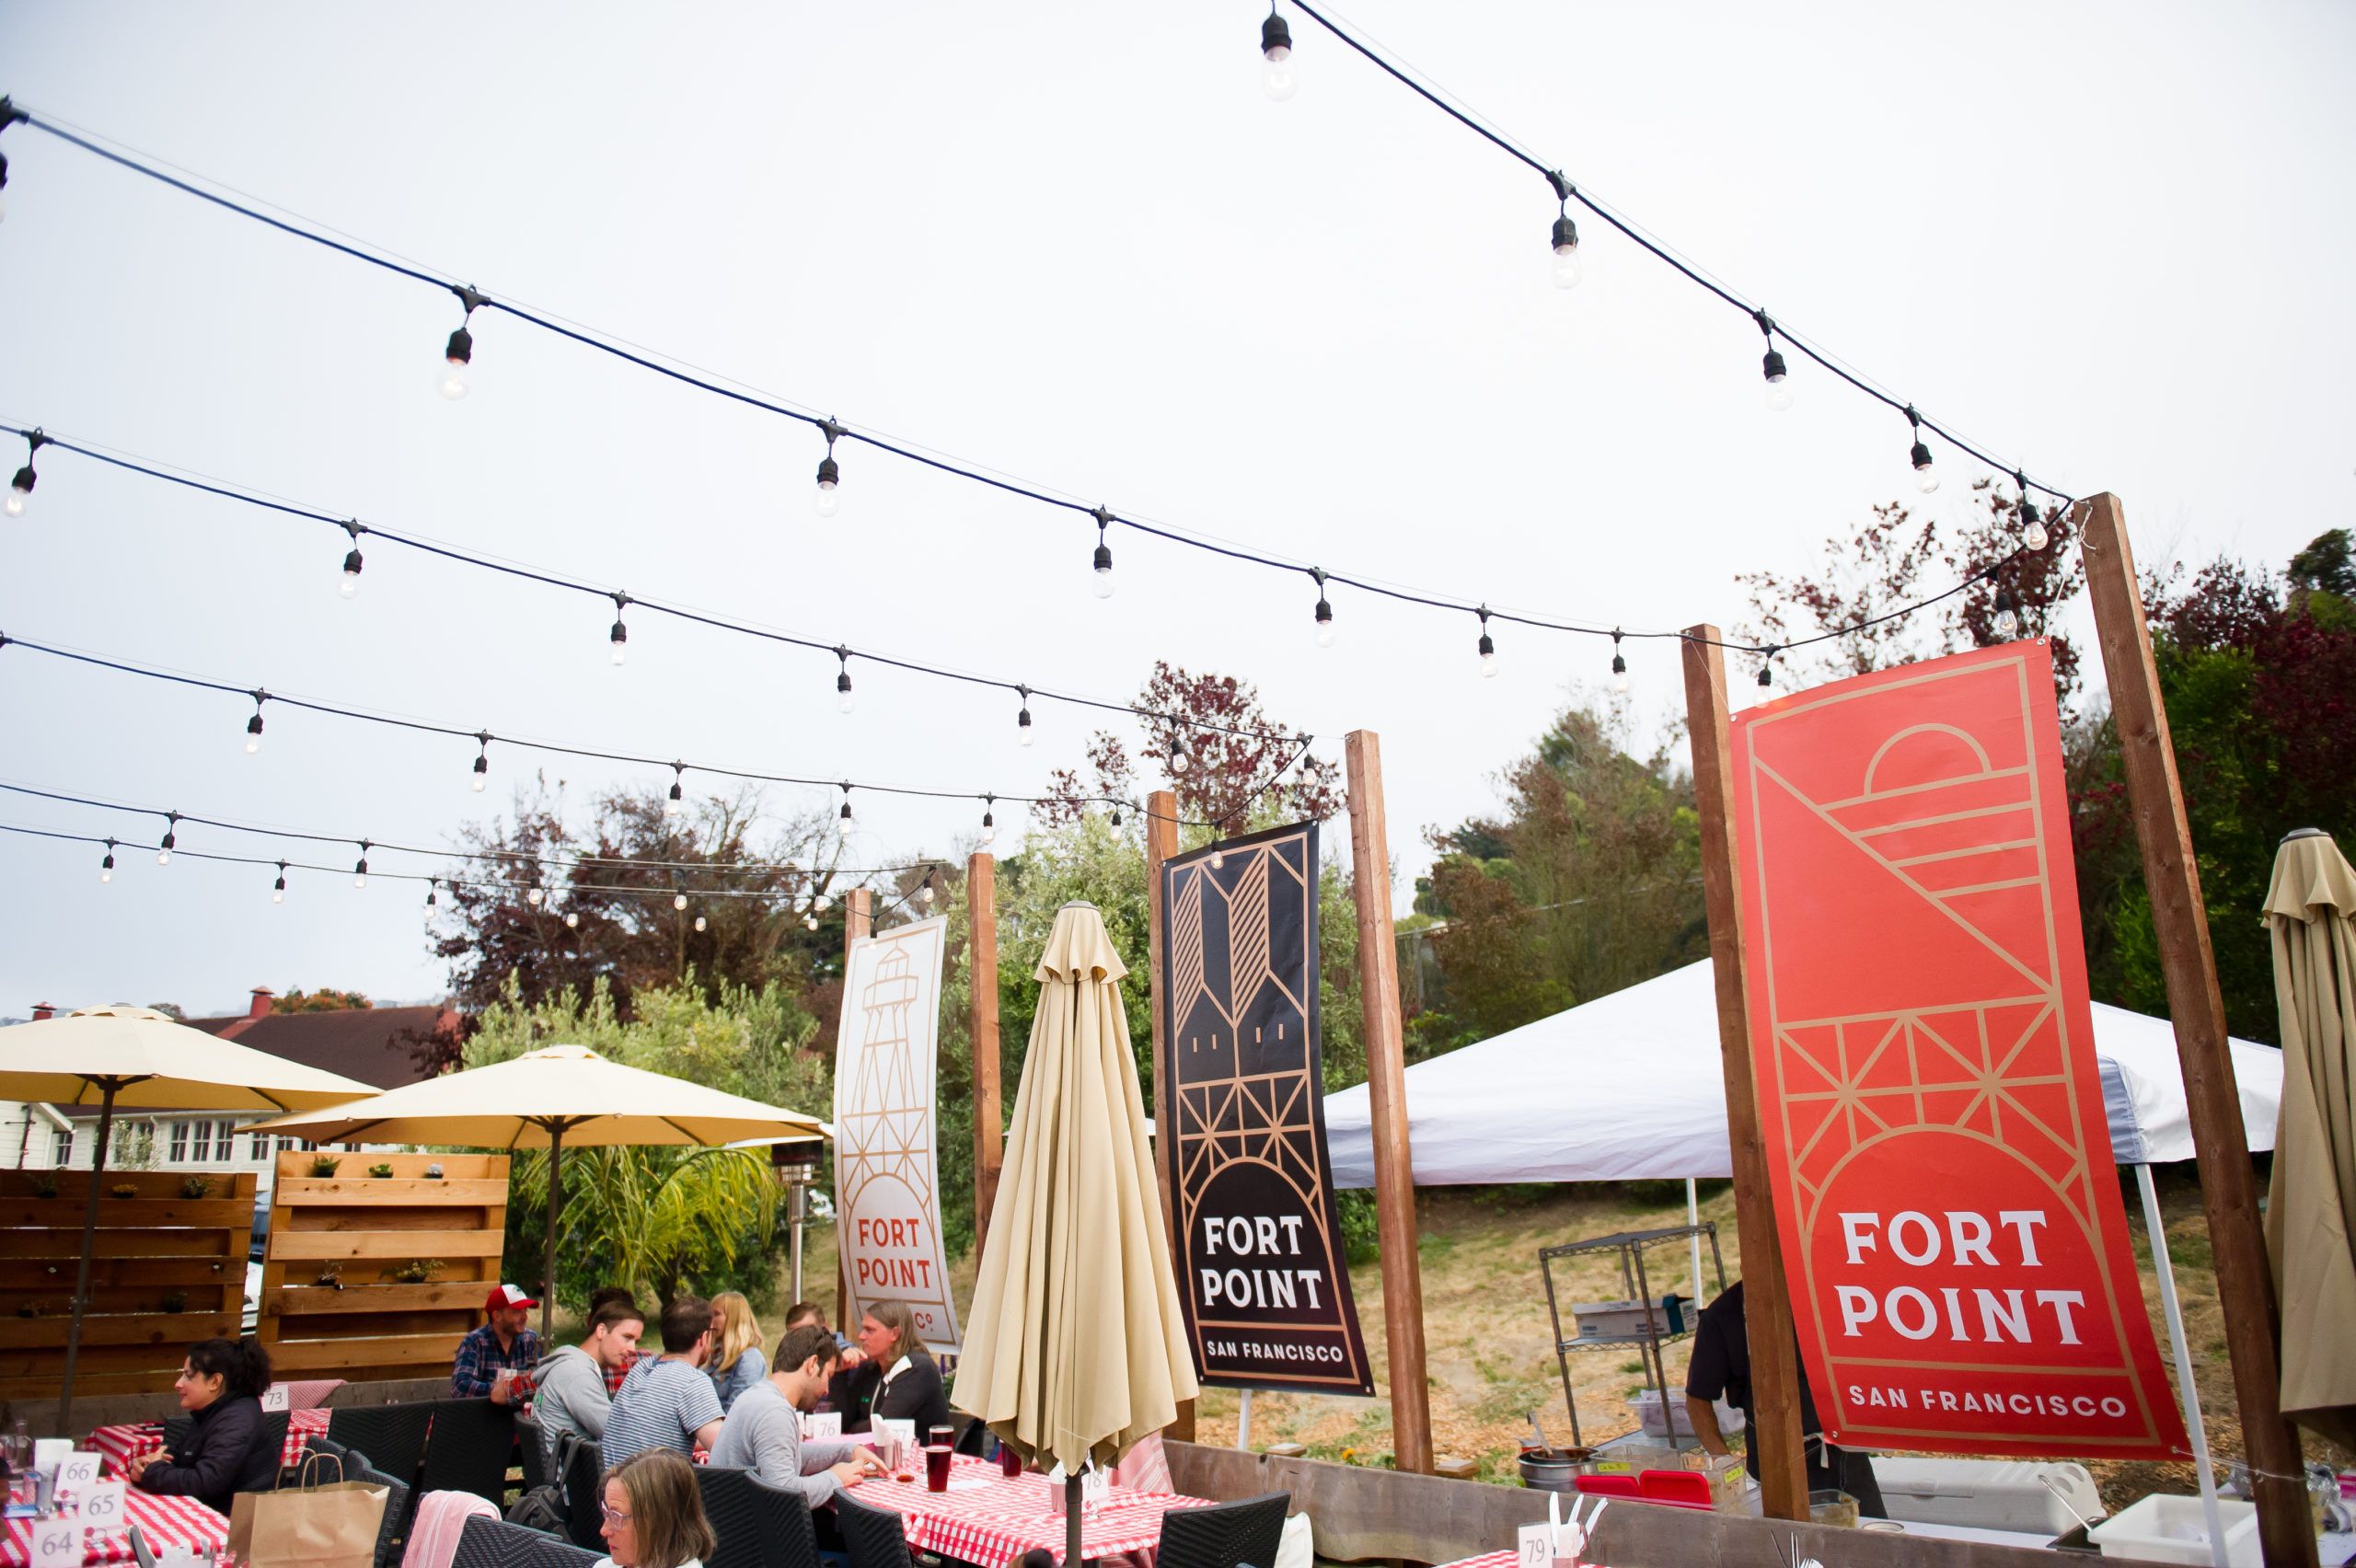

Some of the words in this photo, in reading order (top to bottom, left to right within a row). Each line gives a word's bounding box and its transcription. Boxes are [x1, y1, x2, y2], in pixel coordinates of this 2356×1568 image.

[858, 1218, 918, 1247] FORT
[1203, 1216, 1303, 1255] FORT
[1838, 1210, 2047, 1266] FORT
[857, 1258, 930, 1288] POINT
[1200, 1269, 1322, 1309] POINT
[1833, 1286, 2085, 1345] POINT
[1207, 1341, 1238, 1357] SAN
[1242, 1343, 1344, 1362] FRANCISCO
[267, 1391, 283, 1405] 73
[1849, 1385, 1908, 1408] SAN
[1920, 1389, 2126, 1417] FRANCISCO
[820, 1421, 836, 1436] 76
[66, 1462, 91, 1481] 66
[88, 1494, 114, 1516] 65
[41, 1531, 73, 1556] 64
[1526, 1539, 1545, 1563] 79
